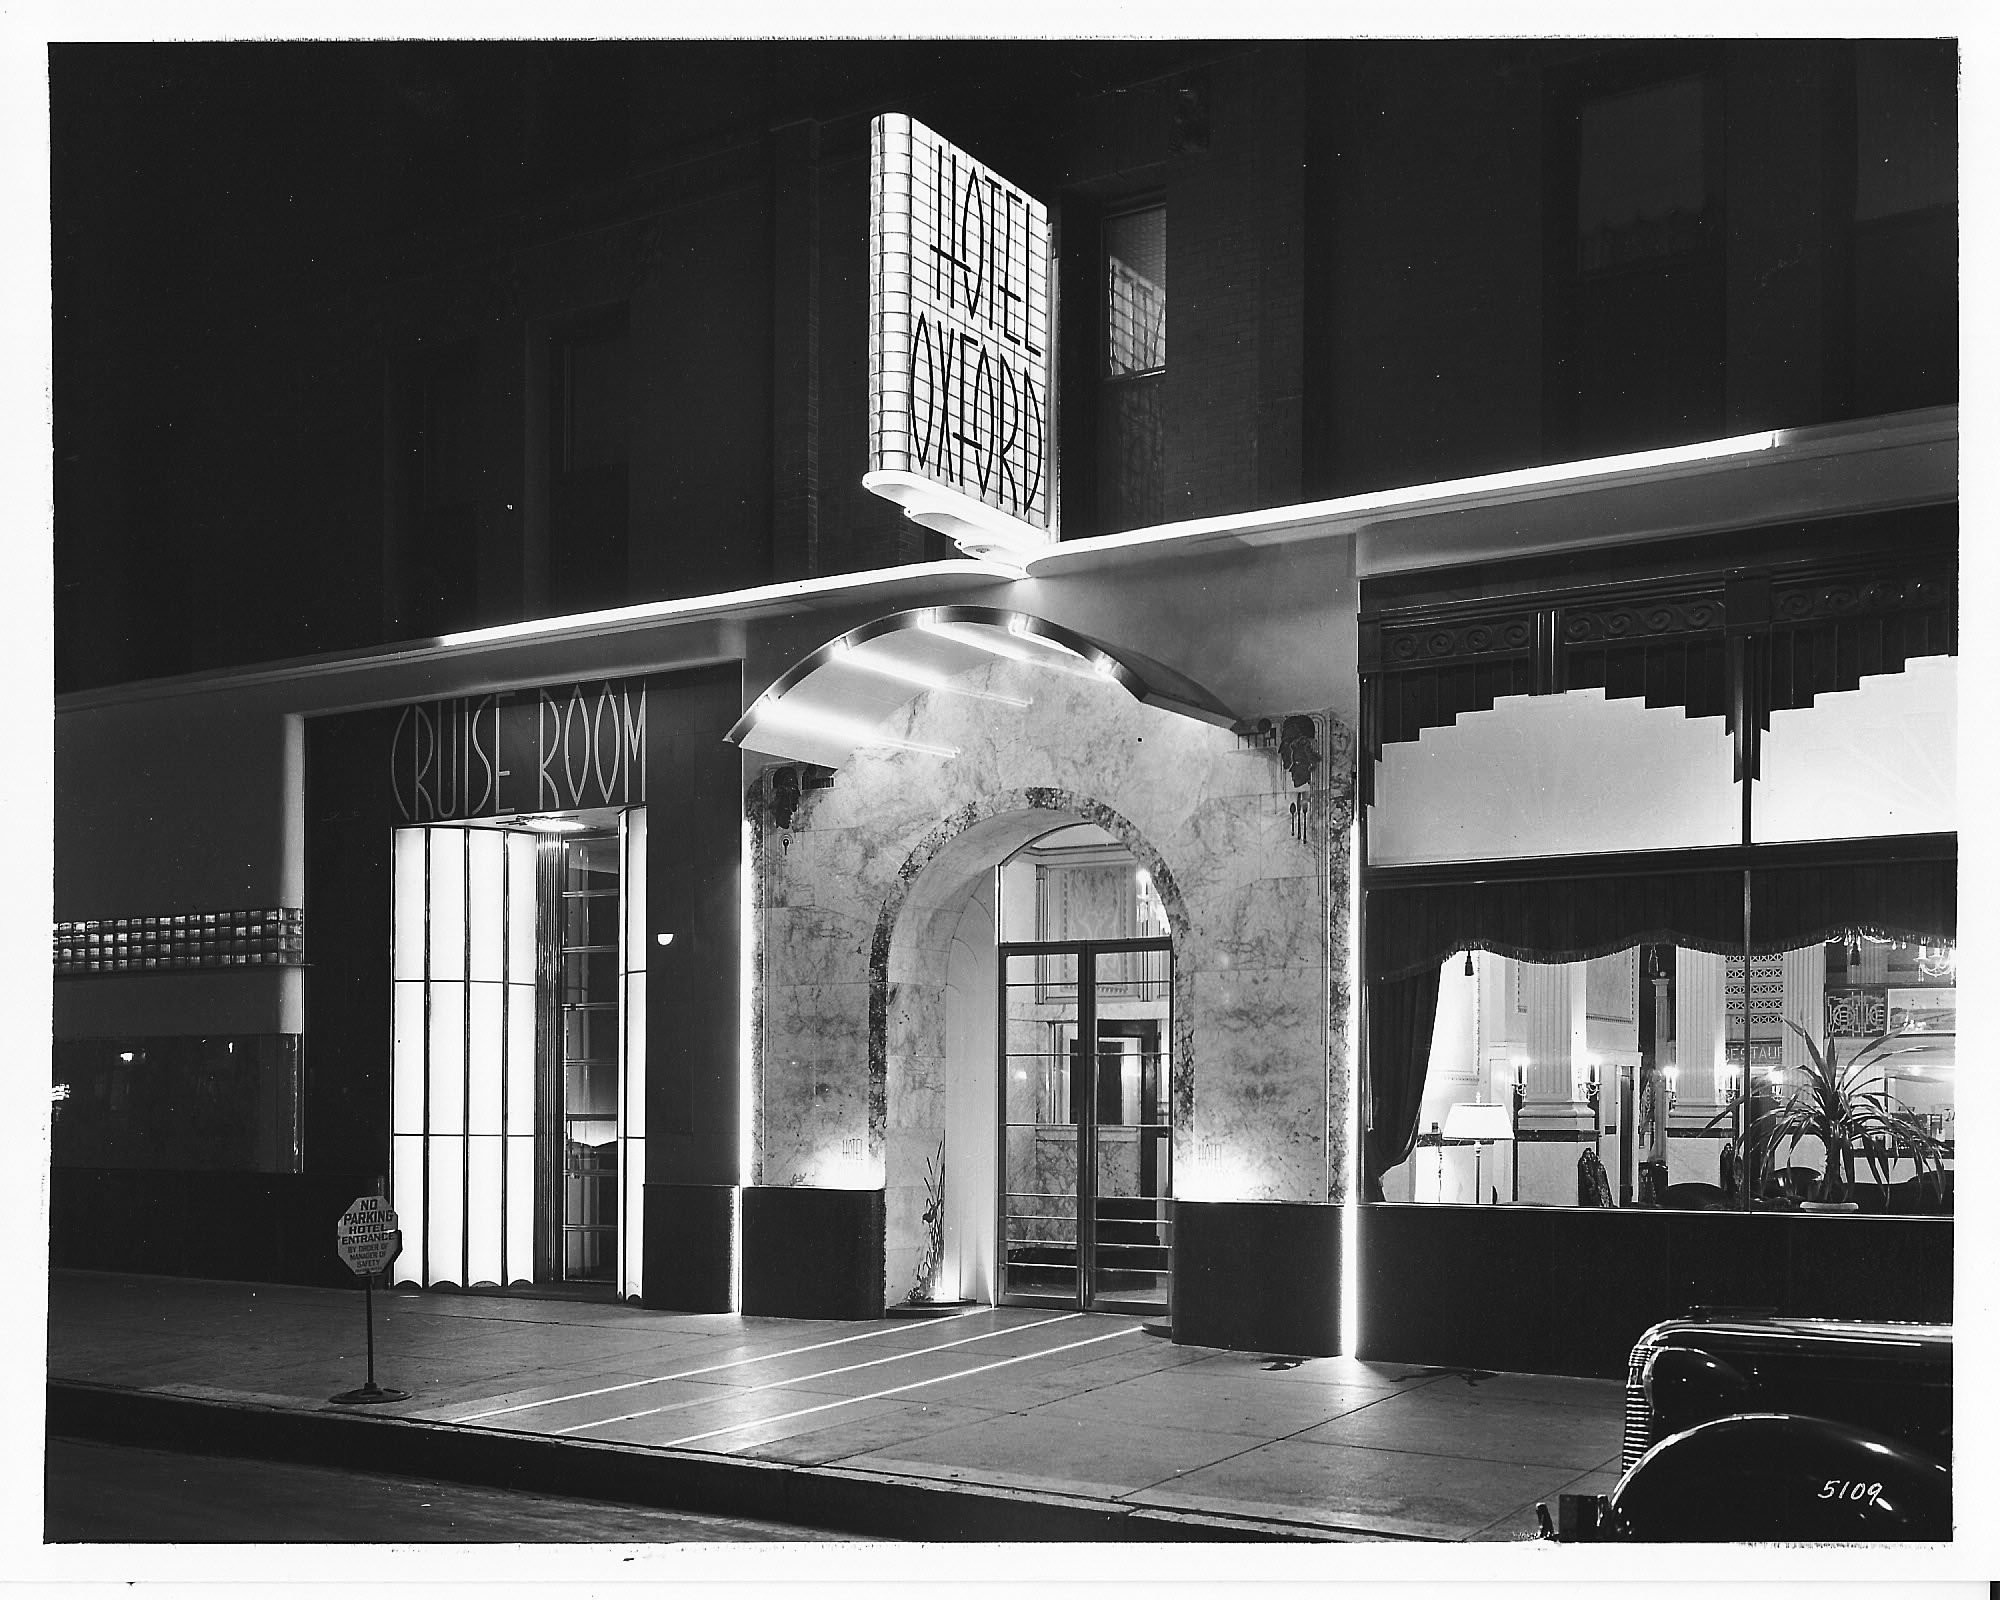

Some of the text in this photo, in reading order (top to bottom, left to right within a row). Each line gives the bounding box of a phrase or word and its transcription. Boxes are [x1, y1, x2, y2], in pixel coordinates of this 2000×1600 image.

[930, 144, 1042, 358] HOTEL
[910, 310, 1043, 516] OXFORD
[391, 679, 647, 822] CRUISE ROOM
[361, 1200, 378, 1211] NO
[344, 1210, 394, 1226] PARKING
[349, 1224, 388, 1234] HOTEL
[342, 1233, 395, 1245] ENTRANCE
[358, 1244, 379, 1253] ORDER
